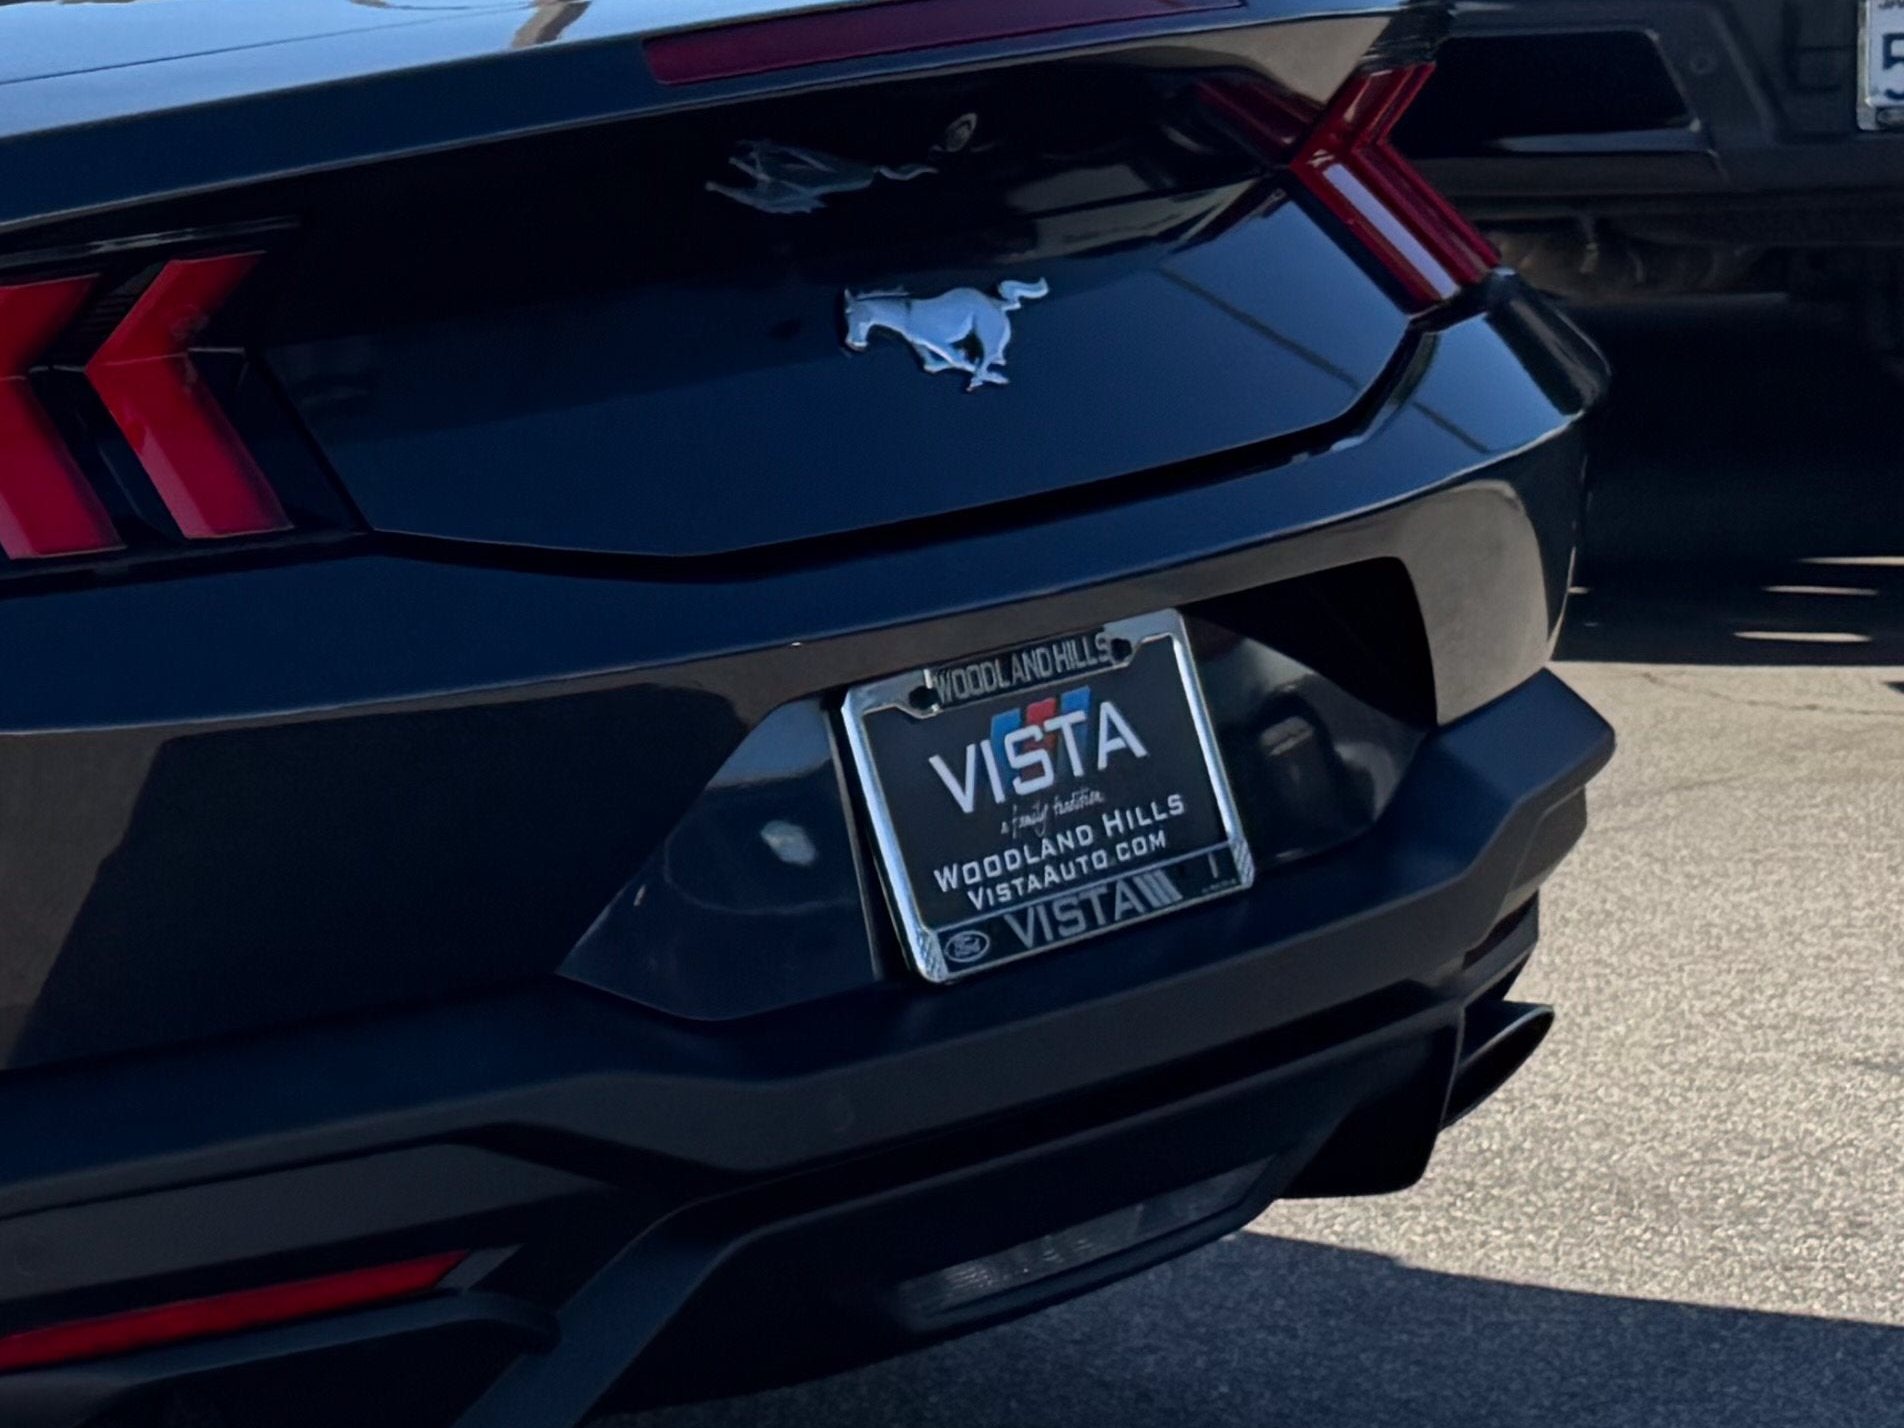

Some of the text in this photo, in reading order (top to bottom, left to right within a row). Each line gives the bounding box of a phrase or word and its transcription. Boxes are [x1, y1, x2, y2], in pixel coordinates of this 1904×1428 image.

[933, 646, 1055, 703] WOODLAND
[929, 700, 1149, 814] VISTA
[933, 793, 1186, 893] WOODLAND HILLS
[1003, 879, 1148, 949] VISTA
